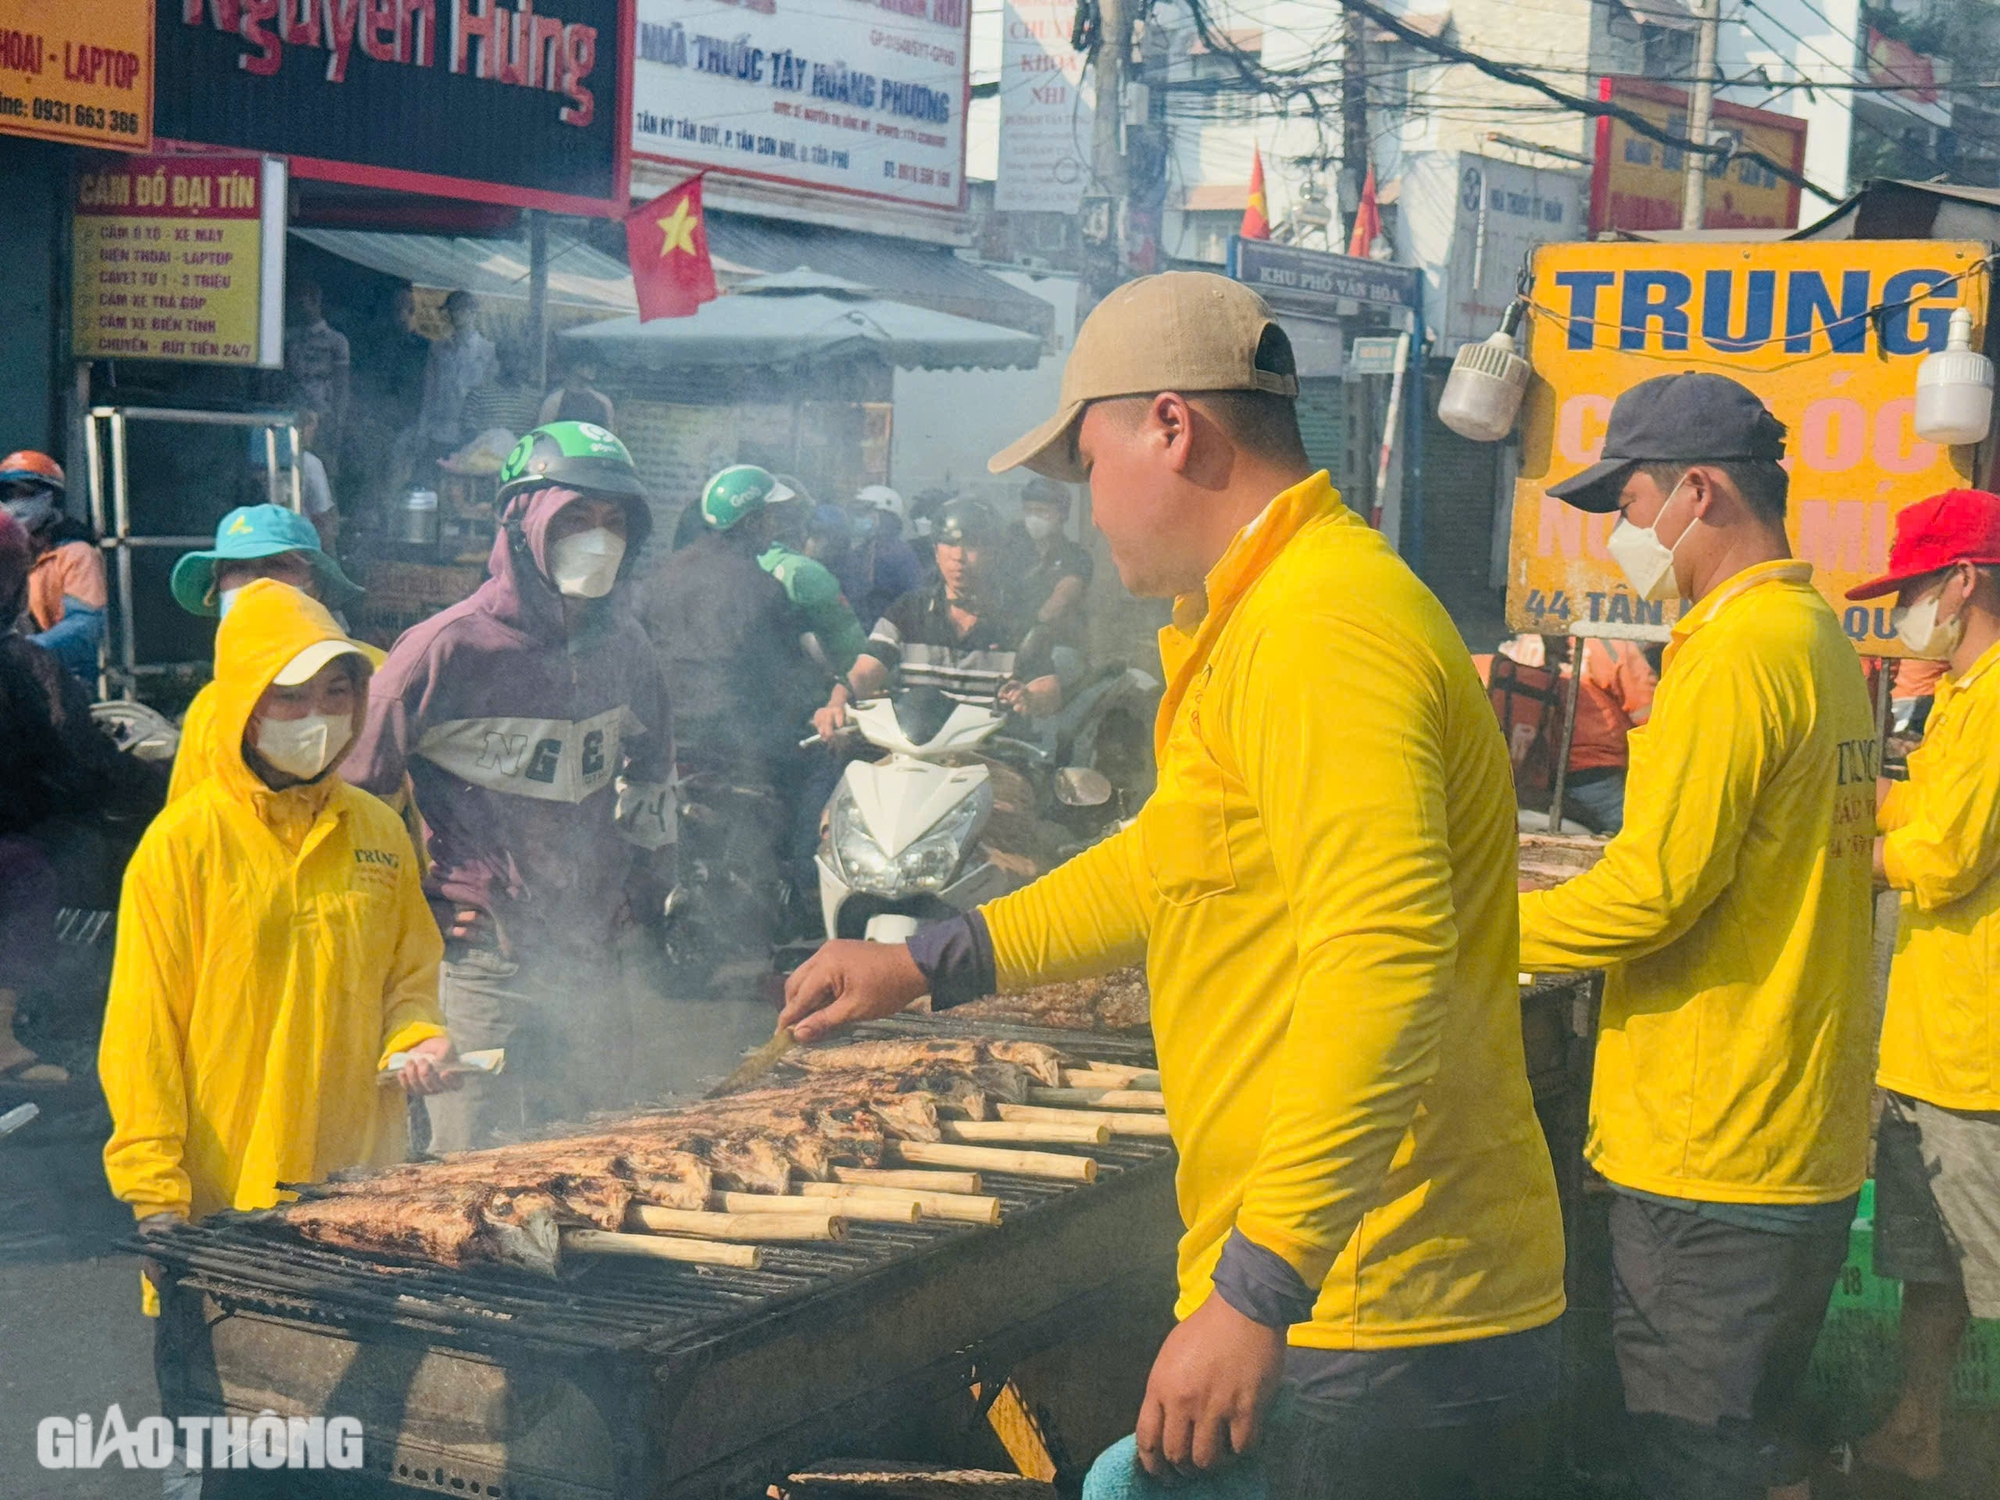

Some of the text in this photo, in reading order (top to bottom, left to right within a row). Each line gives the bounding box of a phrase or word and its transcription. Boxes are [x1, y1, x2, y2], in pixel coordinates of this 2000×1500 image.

[64, 40, 140, 90] LAPTOP
[33, 97, 71, 124] 0931
[1260, 266, 1297, 286] KHU
[1301, 271, 1333, 291] PHỐ
[1555, 269, 1959, 355] TRUNG
[1764, 371, 1938, 474] ÓC
[1525, 589, 1571, 620] 44
[1585, 583, 1663, 626] TÂN
[1843, 606, 1899, 642] QU
